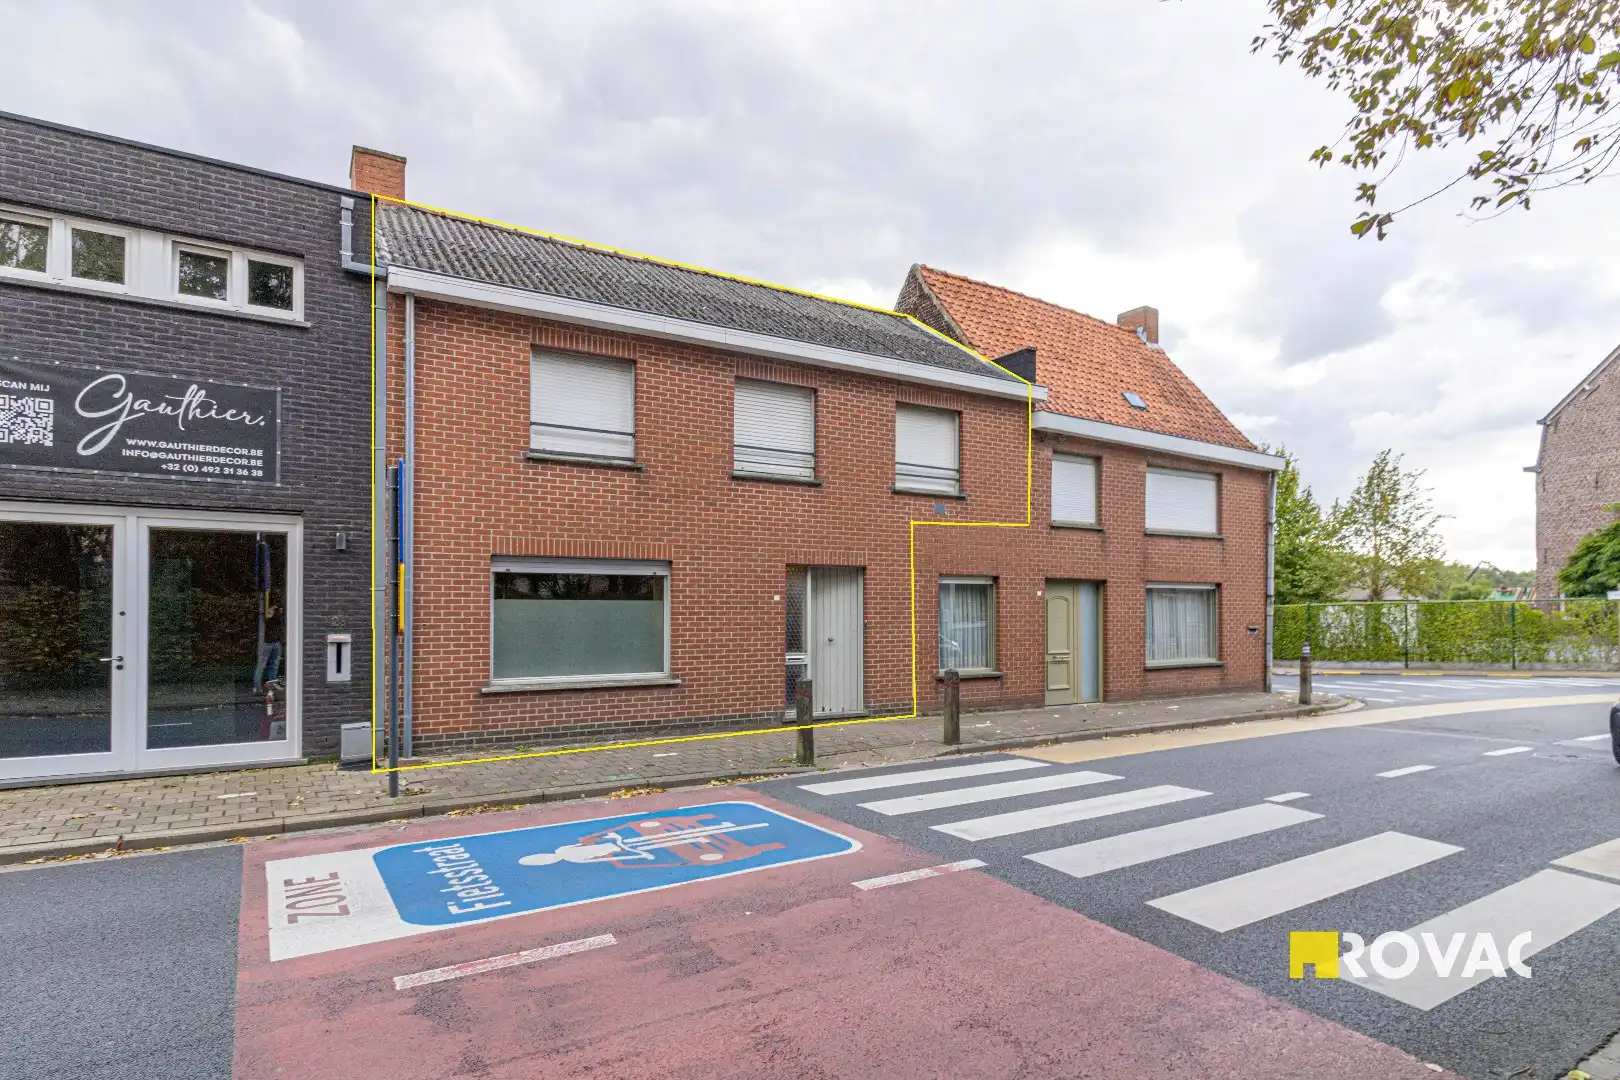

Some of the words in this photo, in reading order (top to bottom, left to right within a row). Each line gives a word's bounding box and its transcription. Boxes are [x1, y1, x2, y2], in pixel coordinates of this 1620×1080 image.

[0, 380, 27, 390] CAN
[30, 383, 50, 392] MIJ
[126, 438, 264, 457] WWW.GAUTHIERDECOR.BE
[121, 449, 264, 467] INFO@GAUTHIERDECOR.BE
[160, 463, 181, 471] +32
[182, 464, 199, 473] (0)
[201, 466, 221, 474] 492
[223, 467, 234, 475] 31
[236, 468, 248, 476] 36
[250, 469, 264, 477] 38
[412, 843, 512, 915] Fietsstraat
[283, 871, 351, 925] ZONE
